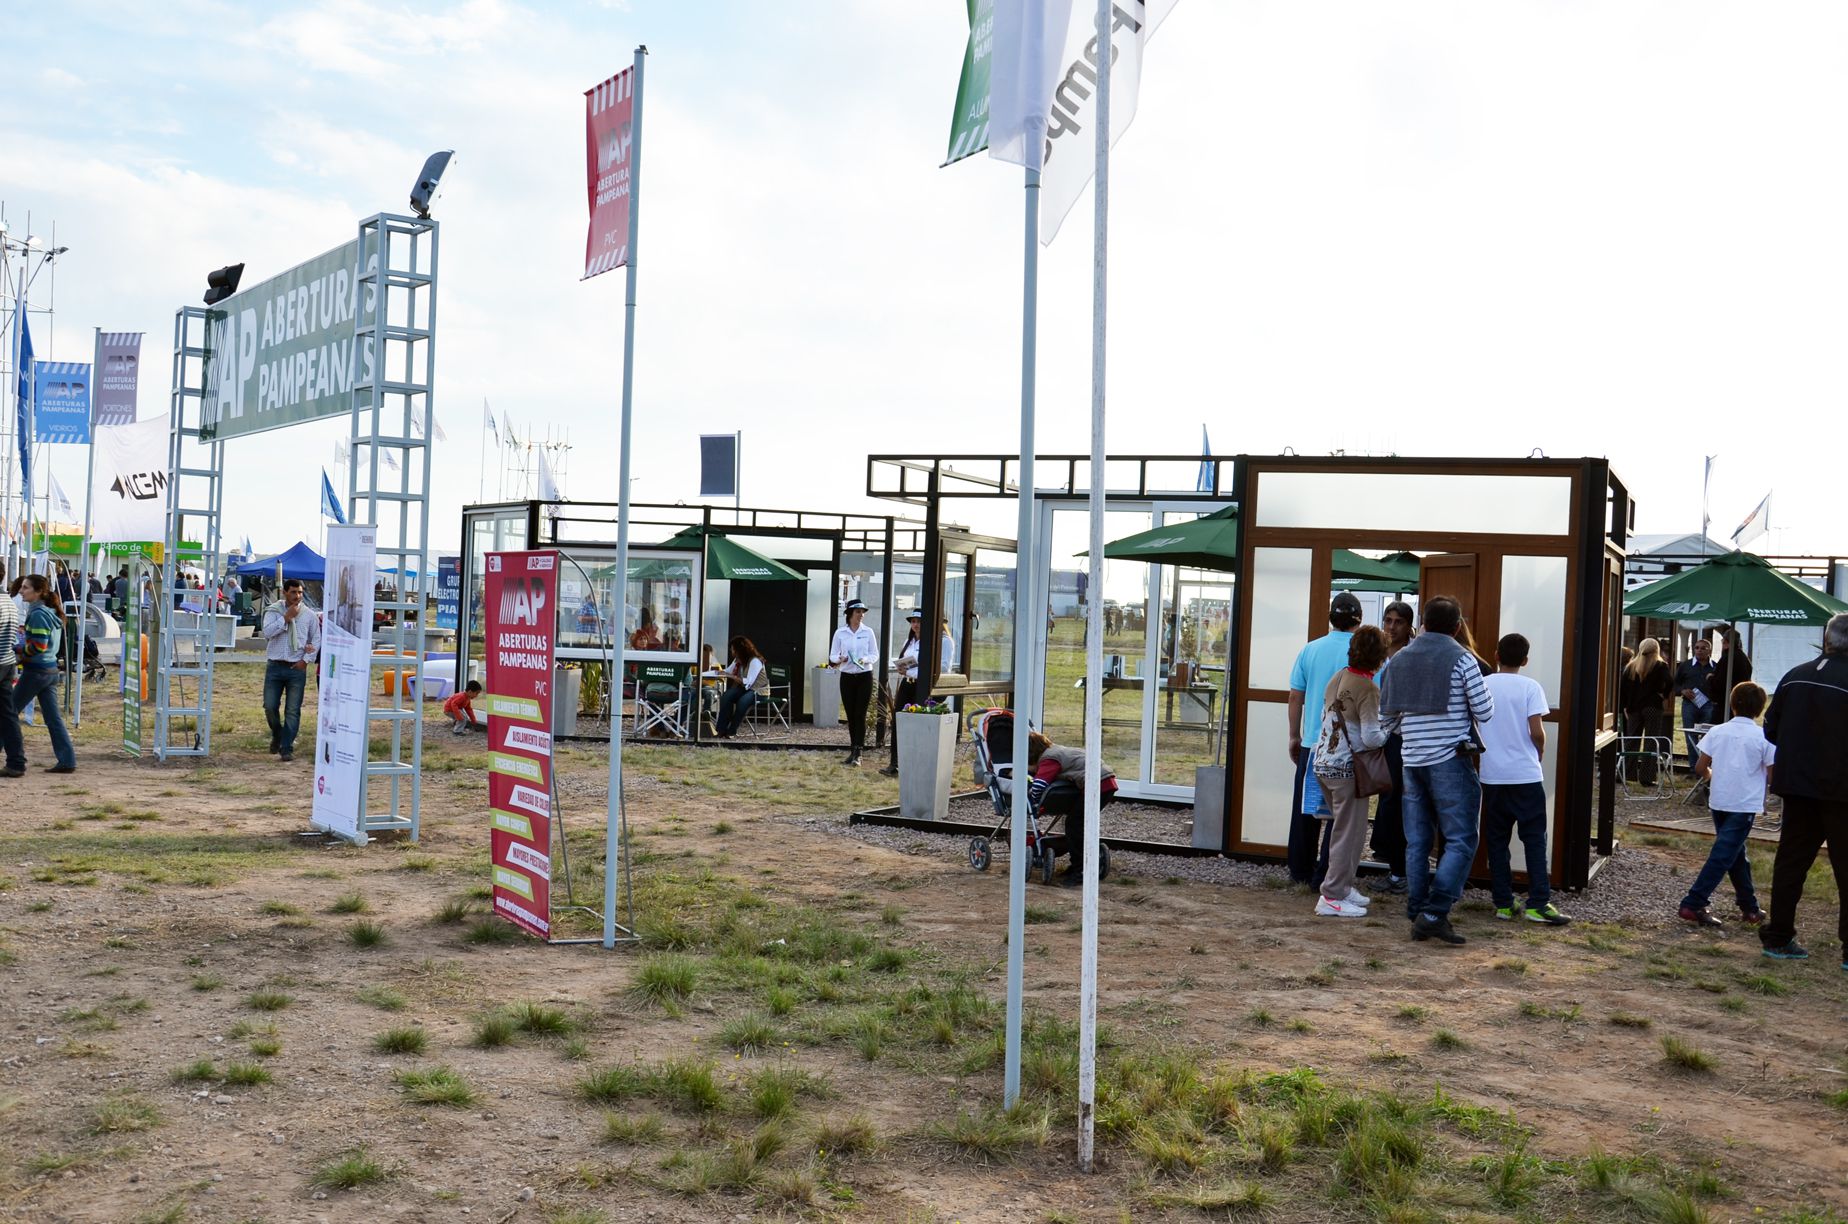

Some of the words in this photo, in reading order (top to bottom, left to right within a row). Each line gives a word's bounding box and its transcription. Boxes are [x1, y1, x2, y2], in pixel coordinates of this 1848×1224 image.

[604, 230, 617, 245] PVC
[216, 307, 258, 422] AP
[103, 376, 136, 384] ABERTURAS
[103, 383, 136, 391] PAMPEANAS
[41, 406, 86, 414] PAMPEANAS
[103, 404, 133, 413] PORTONES
[48, 425, 79, 433] VIDRIOS
[129, 542, 142, 552] de
[512, 577, 546, 626] AP
[499, 633, 547, 651] ABERTURAS
[499, 652, 547, 671] PAMPEANAS
[535, 680, 547, 696] PVC
